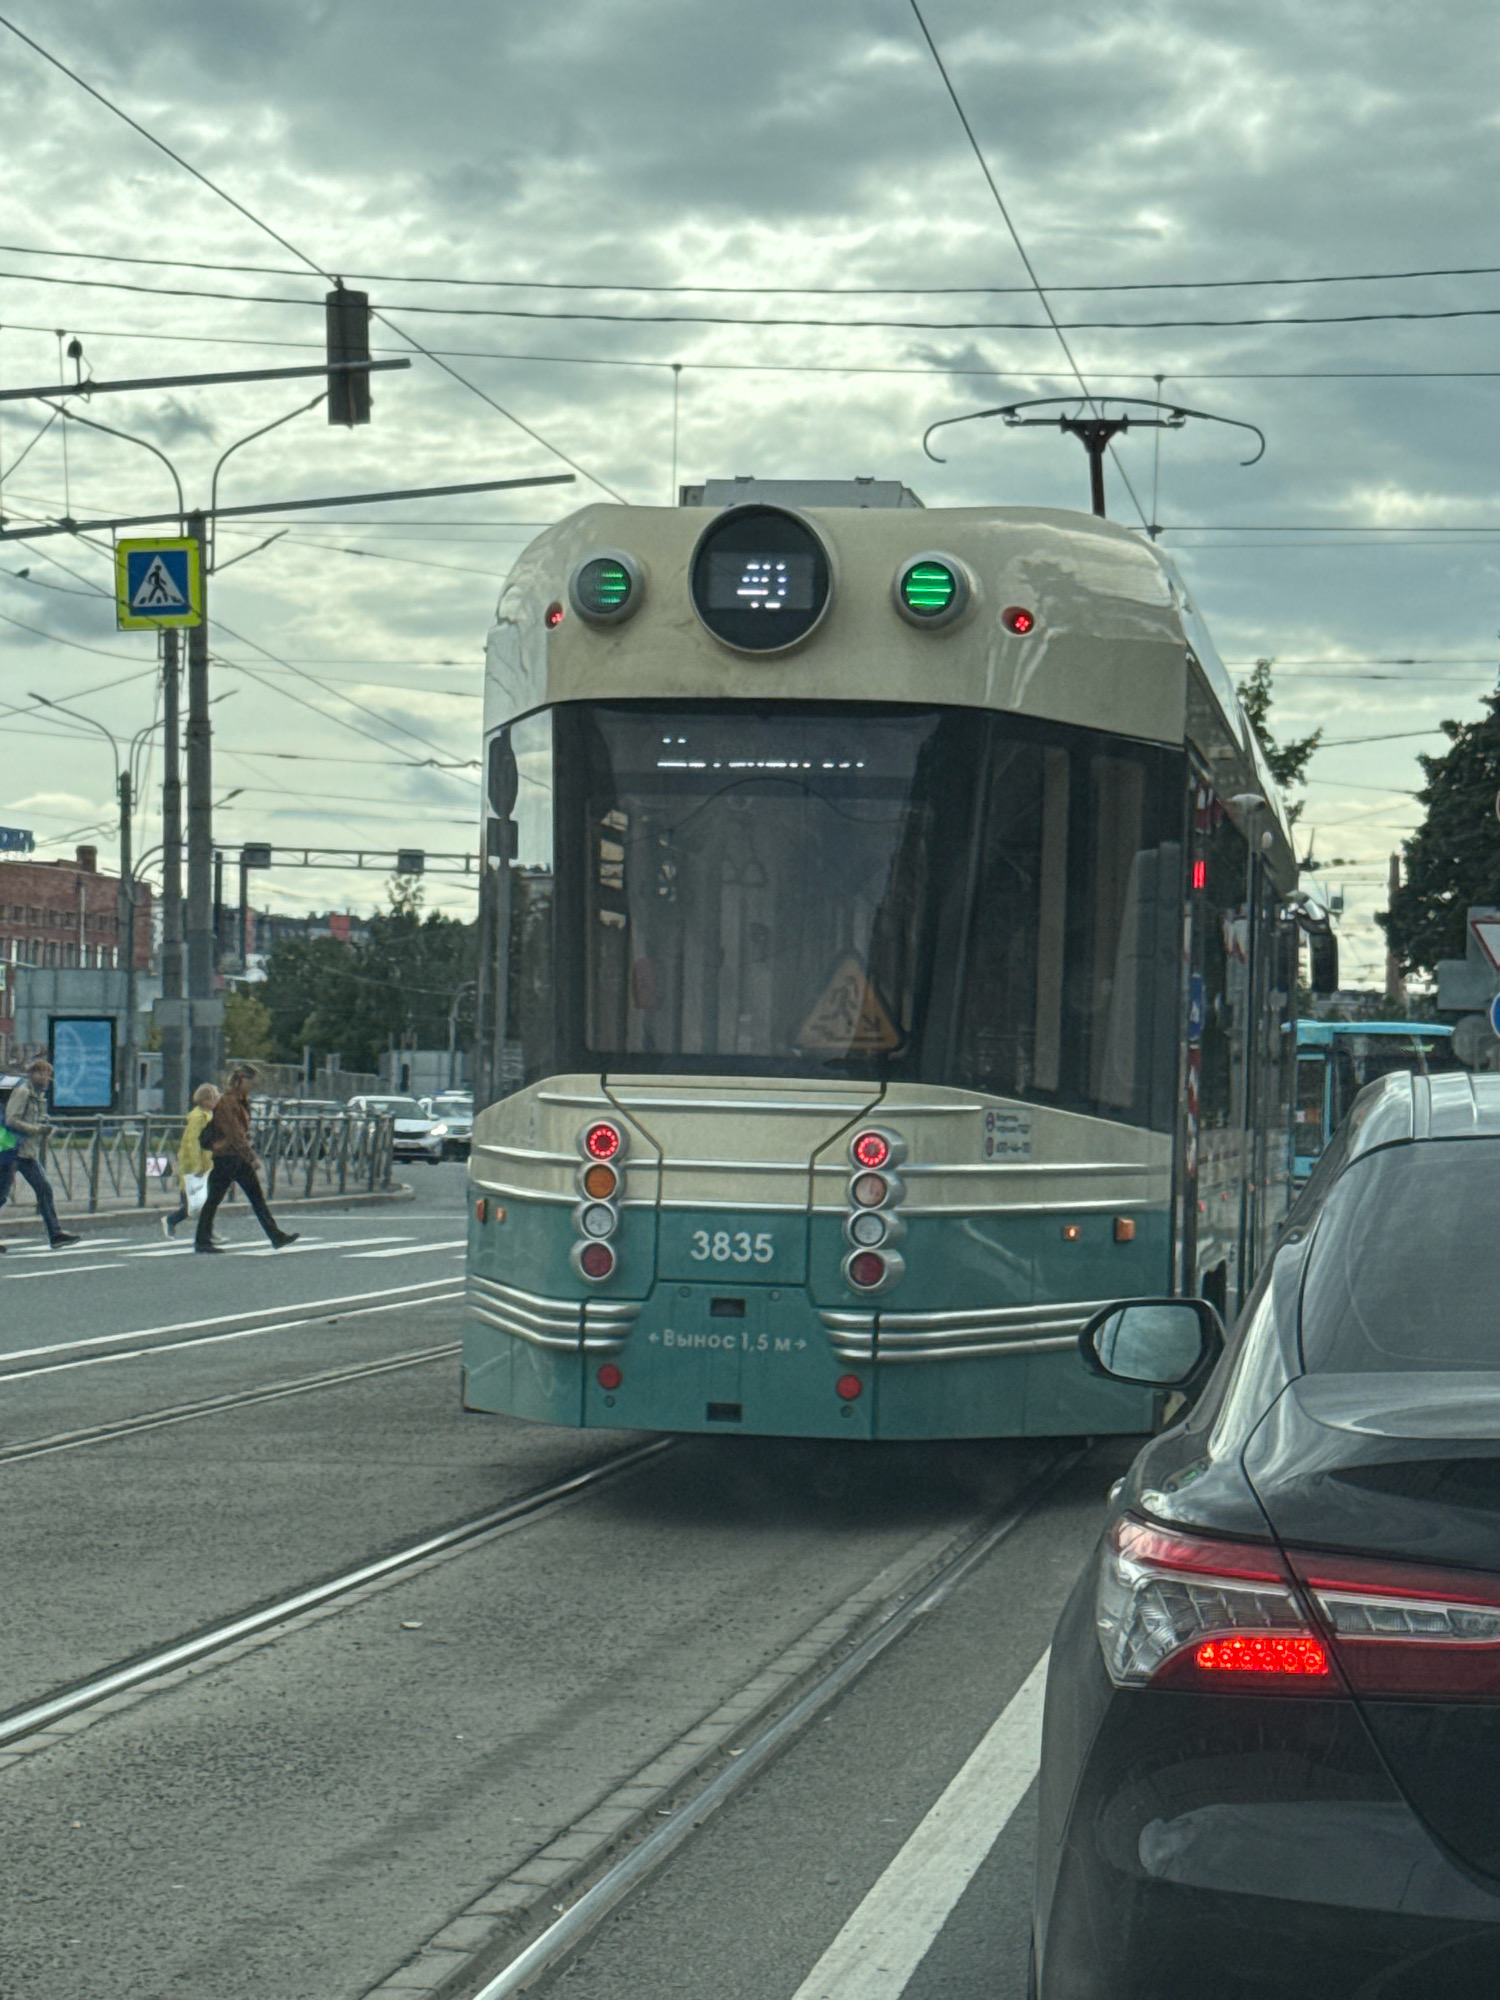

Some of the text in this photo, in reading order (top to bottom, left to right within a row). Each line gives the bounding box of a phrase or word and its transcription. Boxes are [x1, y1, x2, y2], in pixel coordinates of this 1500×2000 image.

[690, 1230, 774, 1263] 3835
[663, 1328, 791, 1352] Вынос 1,5 м
